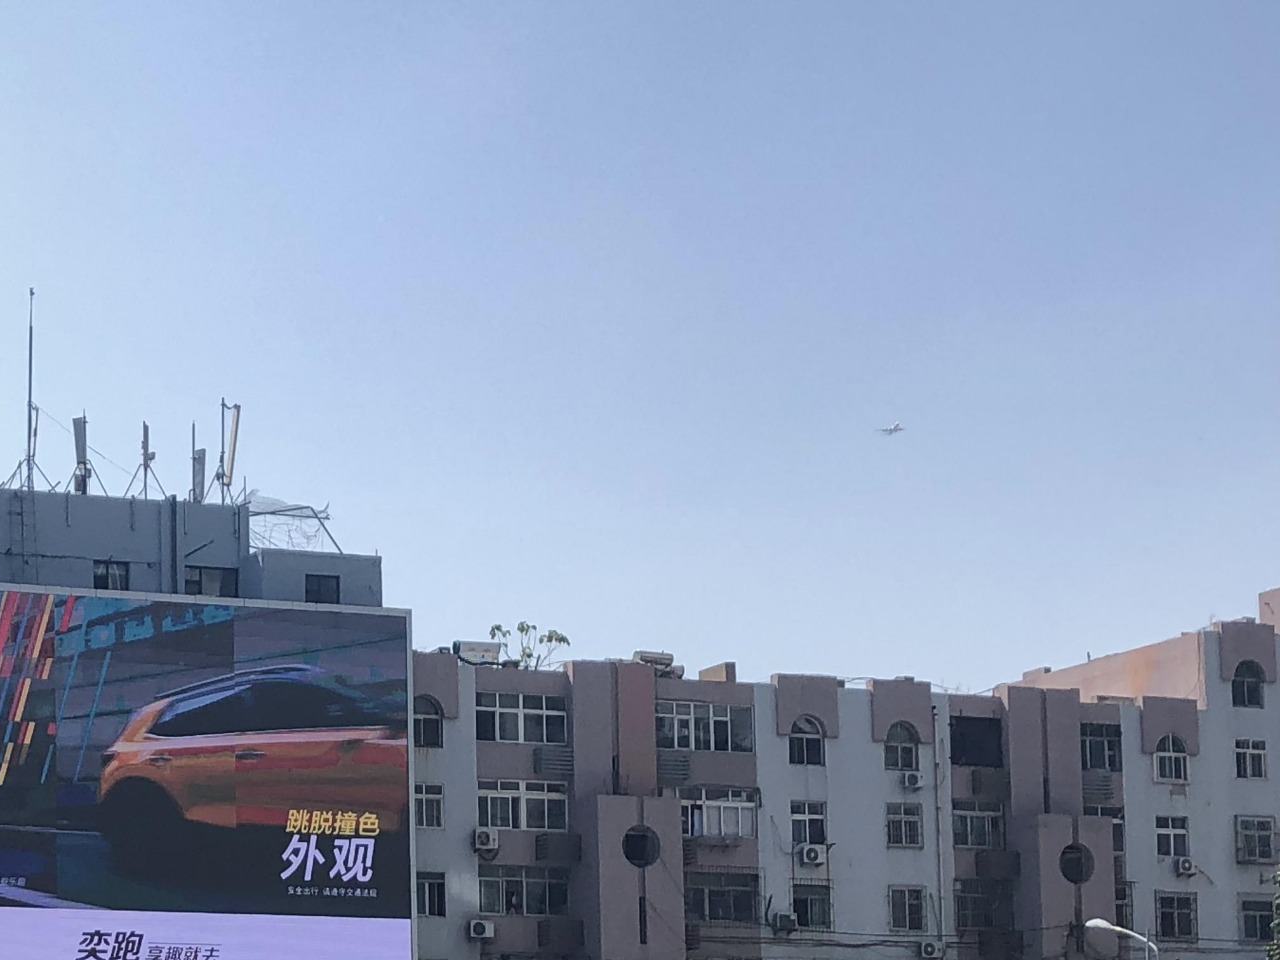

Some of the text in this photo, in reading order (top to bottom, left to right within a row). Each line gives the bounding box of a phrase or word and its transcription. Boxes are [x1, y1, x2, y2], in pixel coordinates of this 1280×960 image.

[285, 808, 381, 836] 跳脱撞色
[280, 834, 375, 883] 外观
